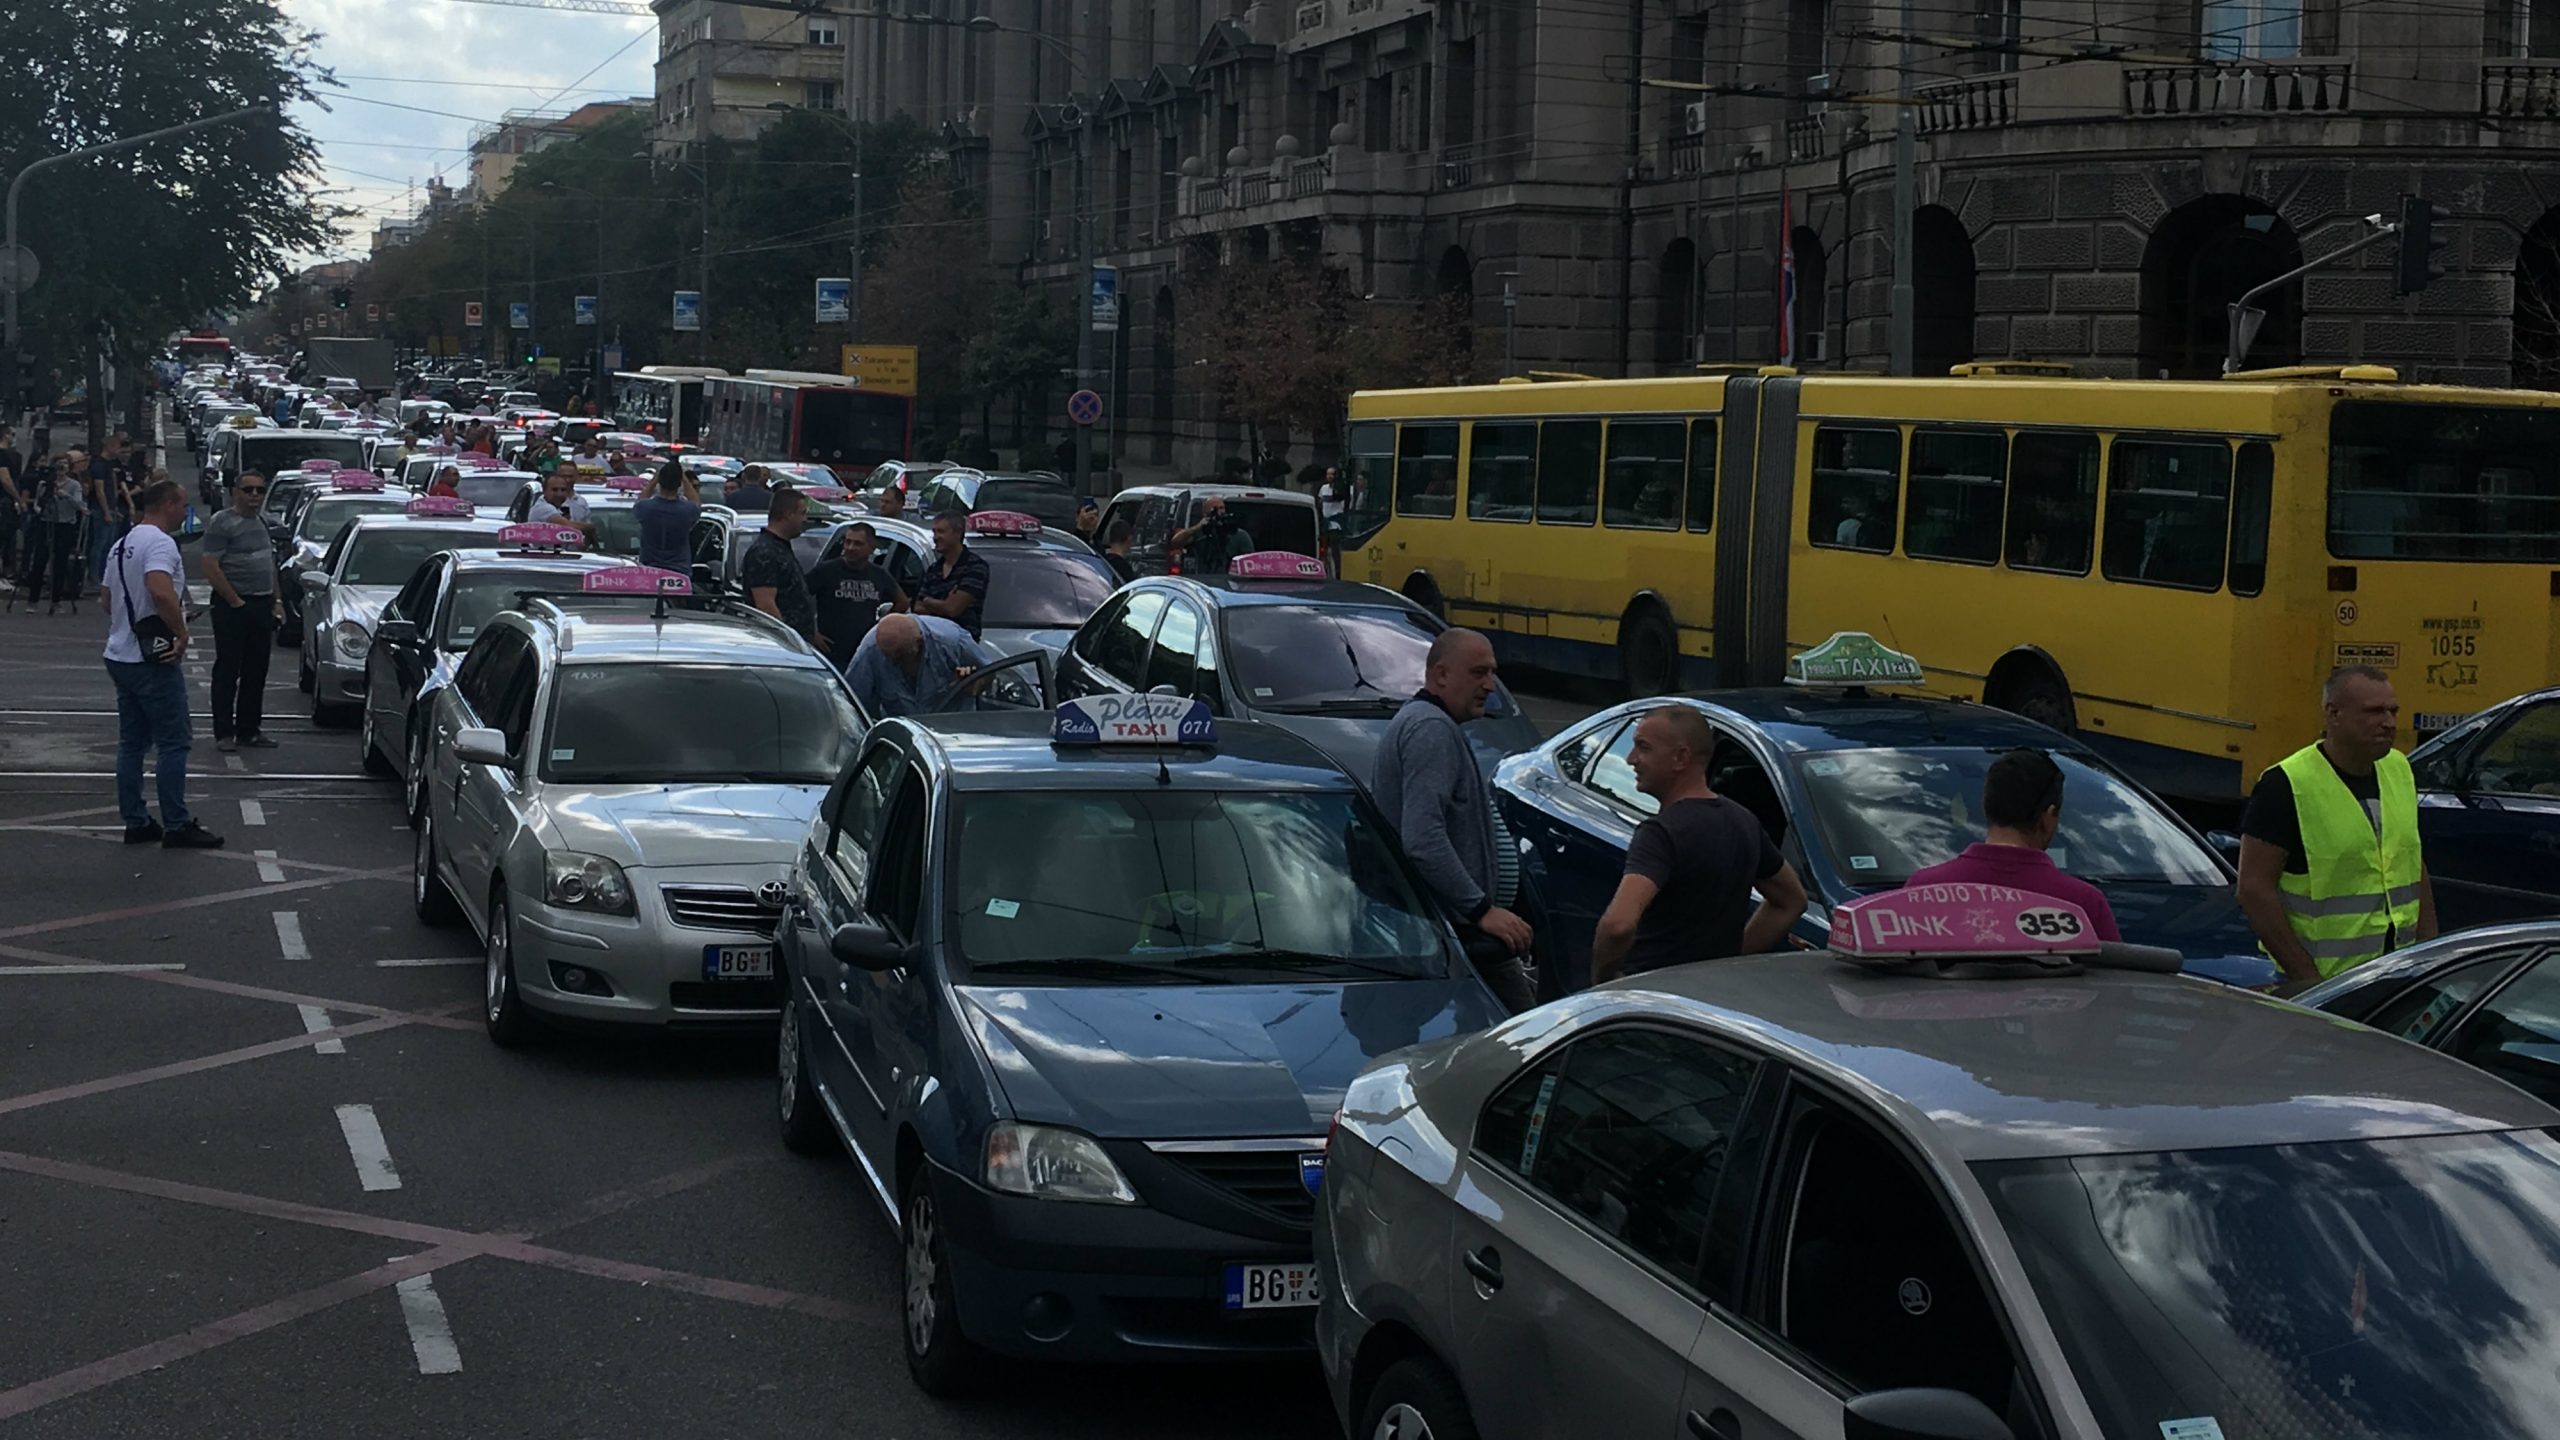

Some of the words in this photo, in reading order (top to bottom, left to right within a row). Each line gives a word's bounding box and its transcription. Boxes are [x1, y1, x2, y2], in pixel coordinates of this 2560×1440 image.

[505, 528, 534, 540] PINK
[559, 532, 577, 541] 159
[591, 574, 628, 589] PINK
[659, 577, 685, 588] 782
[2339, 606, 2354, 620] 50
[2432, 636, 2476, 656] 1055
[570, 671, 604, 680] TAXI
[1835, 658, 1890, 676] TAXI
[1098, 698, 1182, 731] Plavi
[1061, 719, 1094, 735] Radio
[1112, 724, 1167, 736] TAXI
[1182, 721, 1209, 735] 071
[1907, 887, 1970, 903] RADIO
[1975, 887, 2023, 902] TAXI
[1867, 909, 1955, 944] PINK
[2020, 912, 2081, 936] 353
[722, 951, 748, 972] BG
[1250, 1269, 1284, 1302] BG
